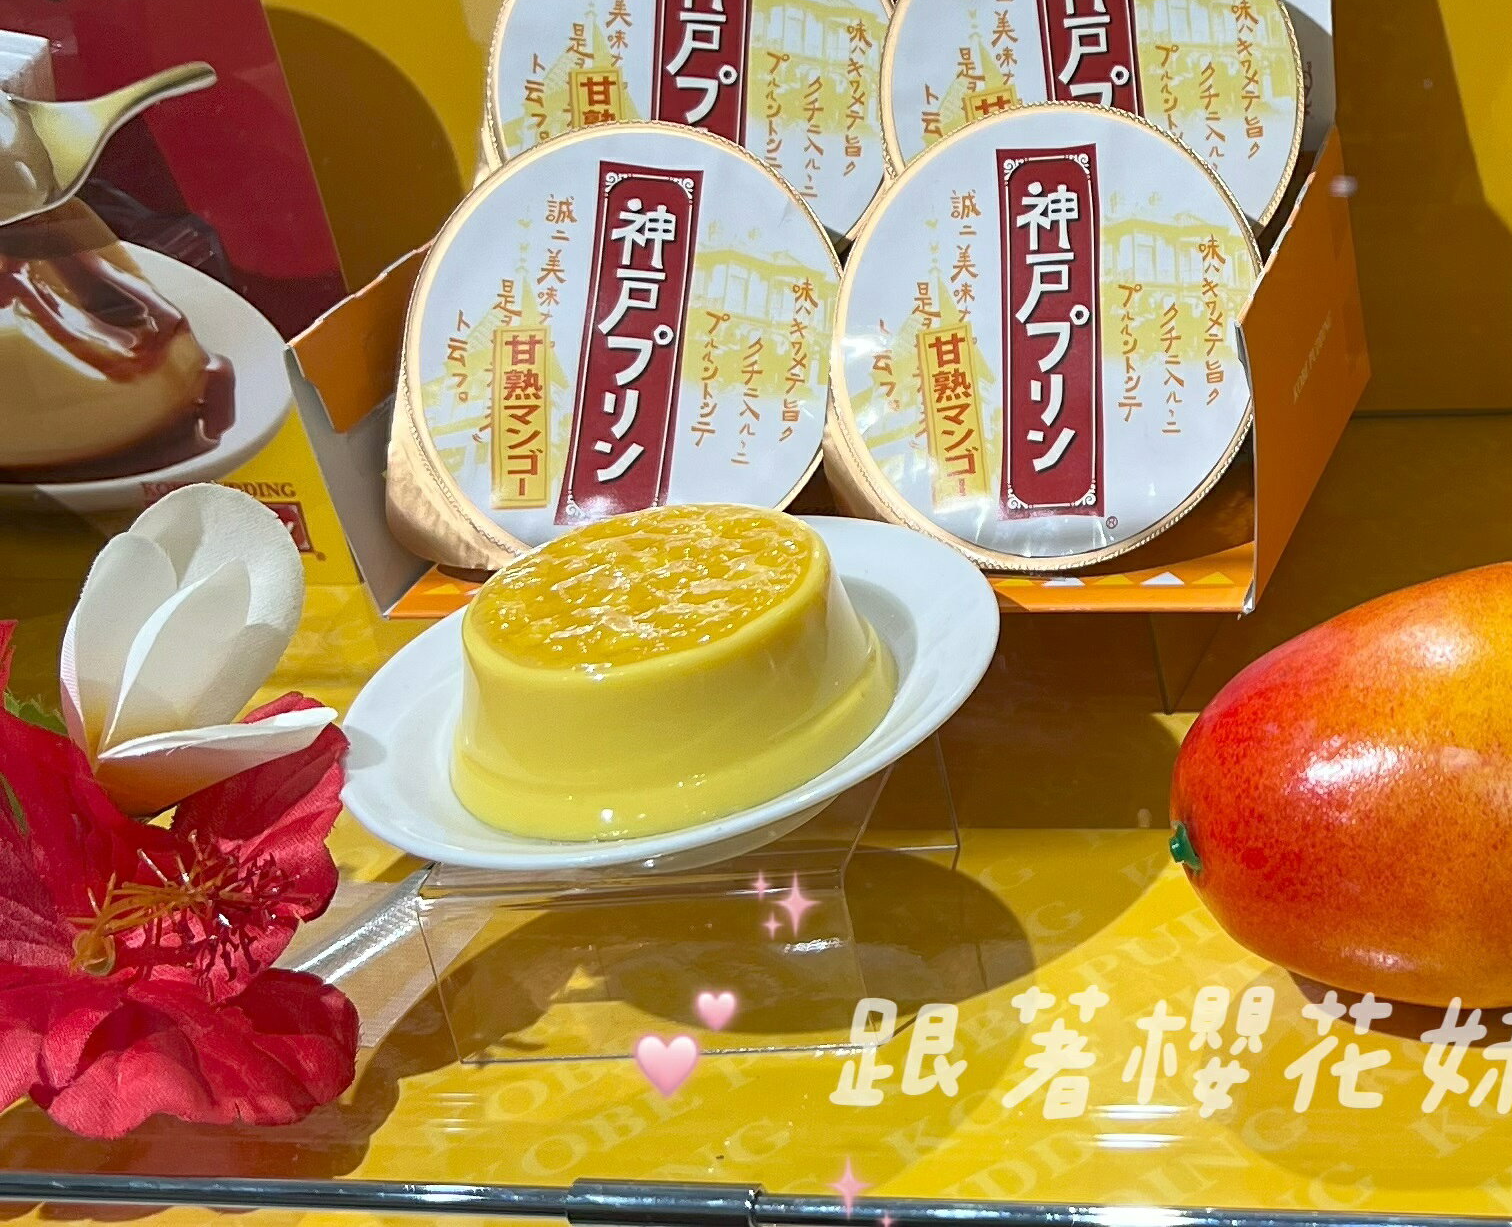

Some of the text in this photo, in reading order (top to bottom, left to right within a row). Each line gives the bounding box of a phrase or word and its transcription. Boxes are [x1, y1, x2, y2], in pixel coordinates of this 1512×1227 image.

[536, 193, 578, 324] 誠ニ美味ナ
[949, 189, 982, 323] 誠ニ美味ナ
[1015, 180, 1091, 473] 神戸プリン
[501, 333, 546, 497] 甘熟マンゴー
[592, 197, 677, 485] 神戸プリン
[928, 332, 978, 497] 甘熟マンゴー
